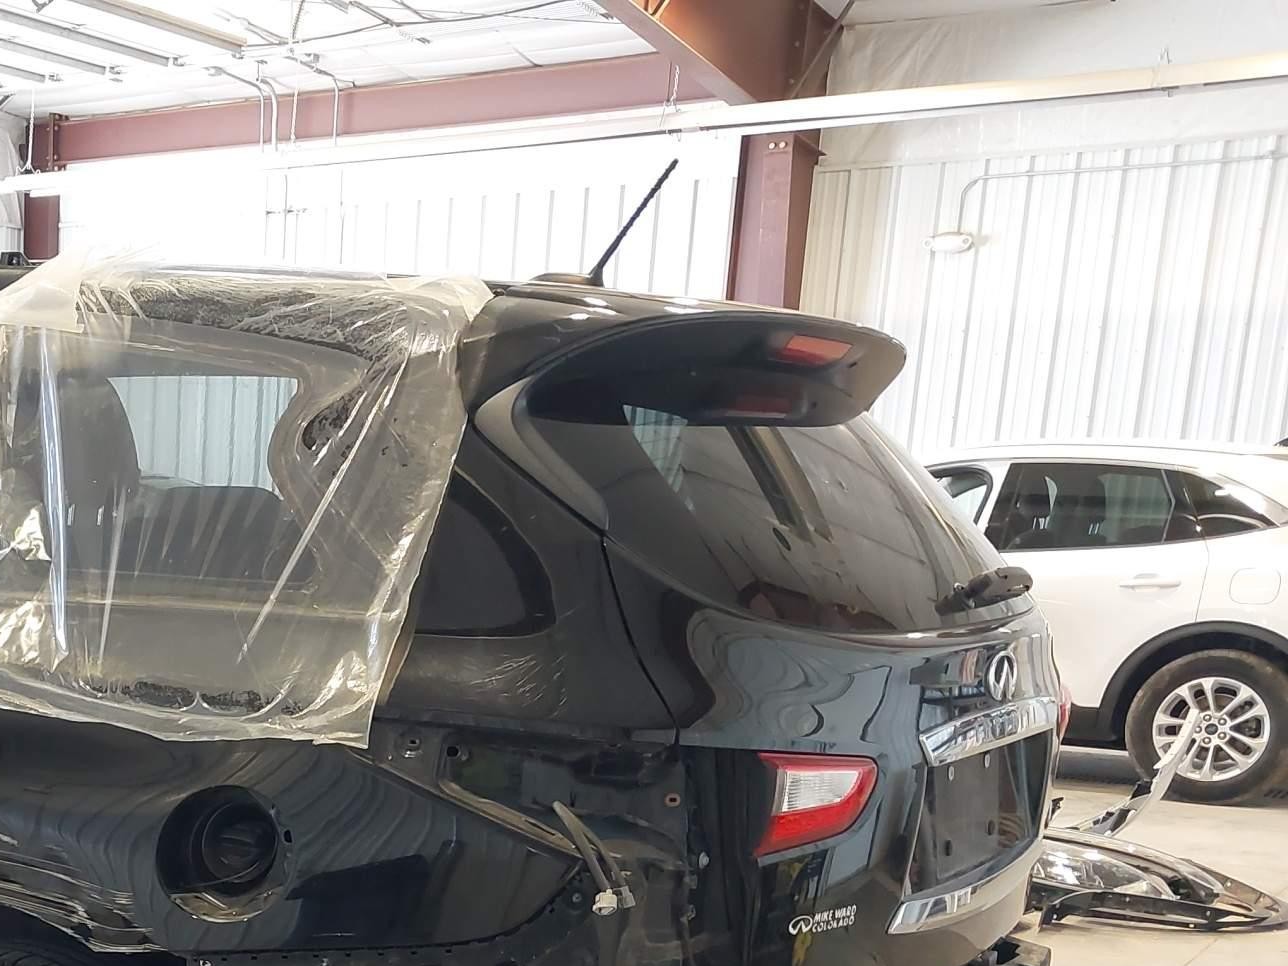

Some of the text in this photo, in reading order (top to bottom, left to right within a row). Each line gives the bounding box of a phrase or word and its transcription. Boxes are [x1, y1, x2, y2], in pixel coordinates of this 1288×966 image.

[813, 903, 857, 923] MIKE WARD
[812, 915, 855, 933] COLORADO
